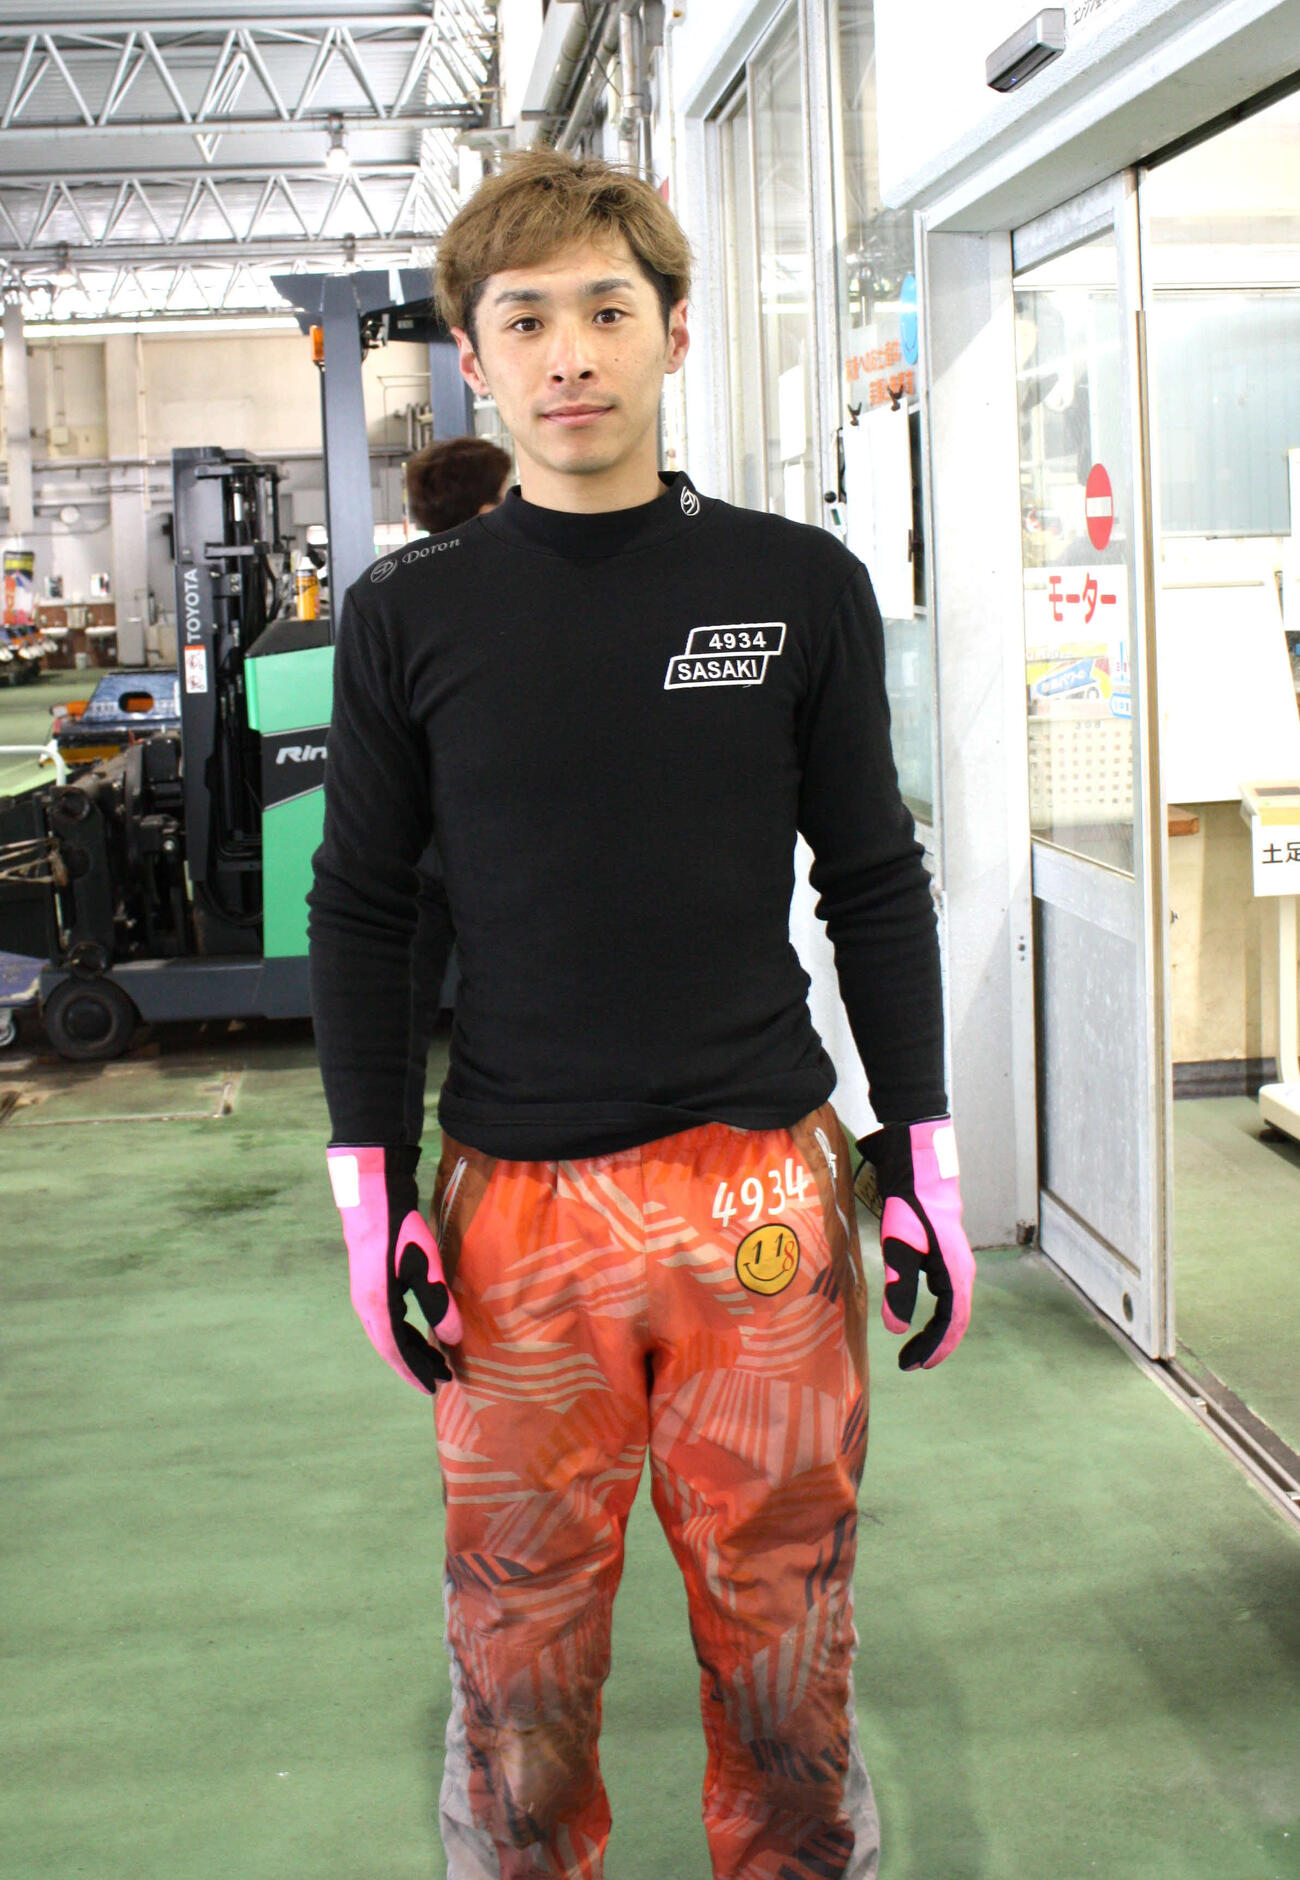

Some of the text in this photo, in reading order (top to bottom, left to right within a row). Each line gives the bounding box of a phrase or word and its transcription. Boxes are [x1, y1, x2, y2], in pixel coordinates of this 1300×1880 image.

[402, 538, 460, 564] Doron
[184, 568, 202, 643] TOYOTA
[1048, 572, 1117, 624] モーター
[708, 631, 767, 650] 4934
[677, 659, 758, 680] SASAKI
[1262, 842, 1300, 864] 土足
[711, 1157, 809, 1228] 4934
